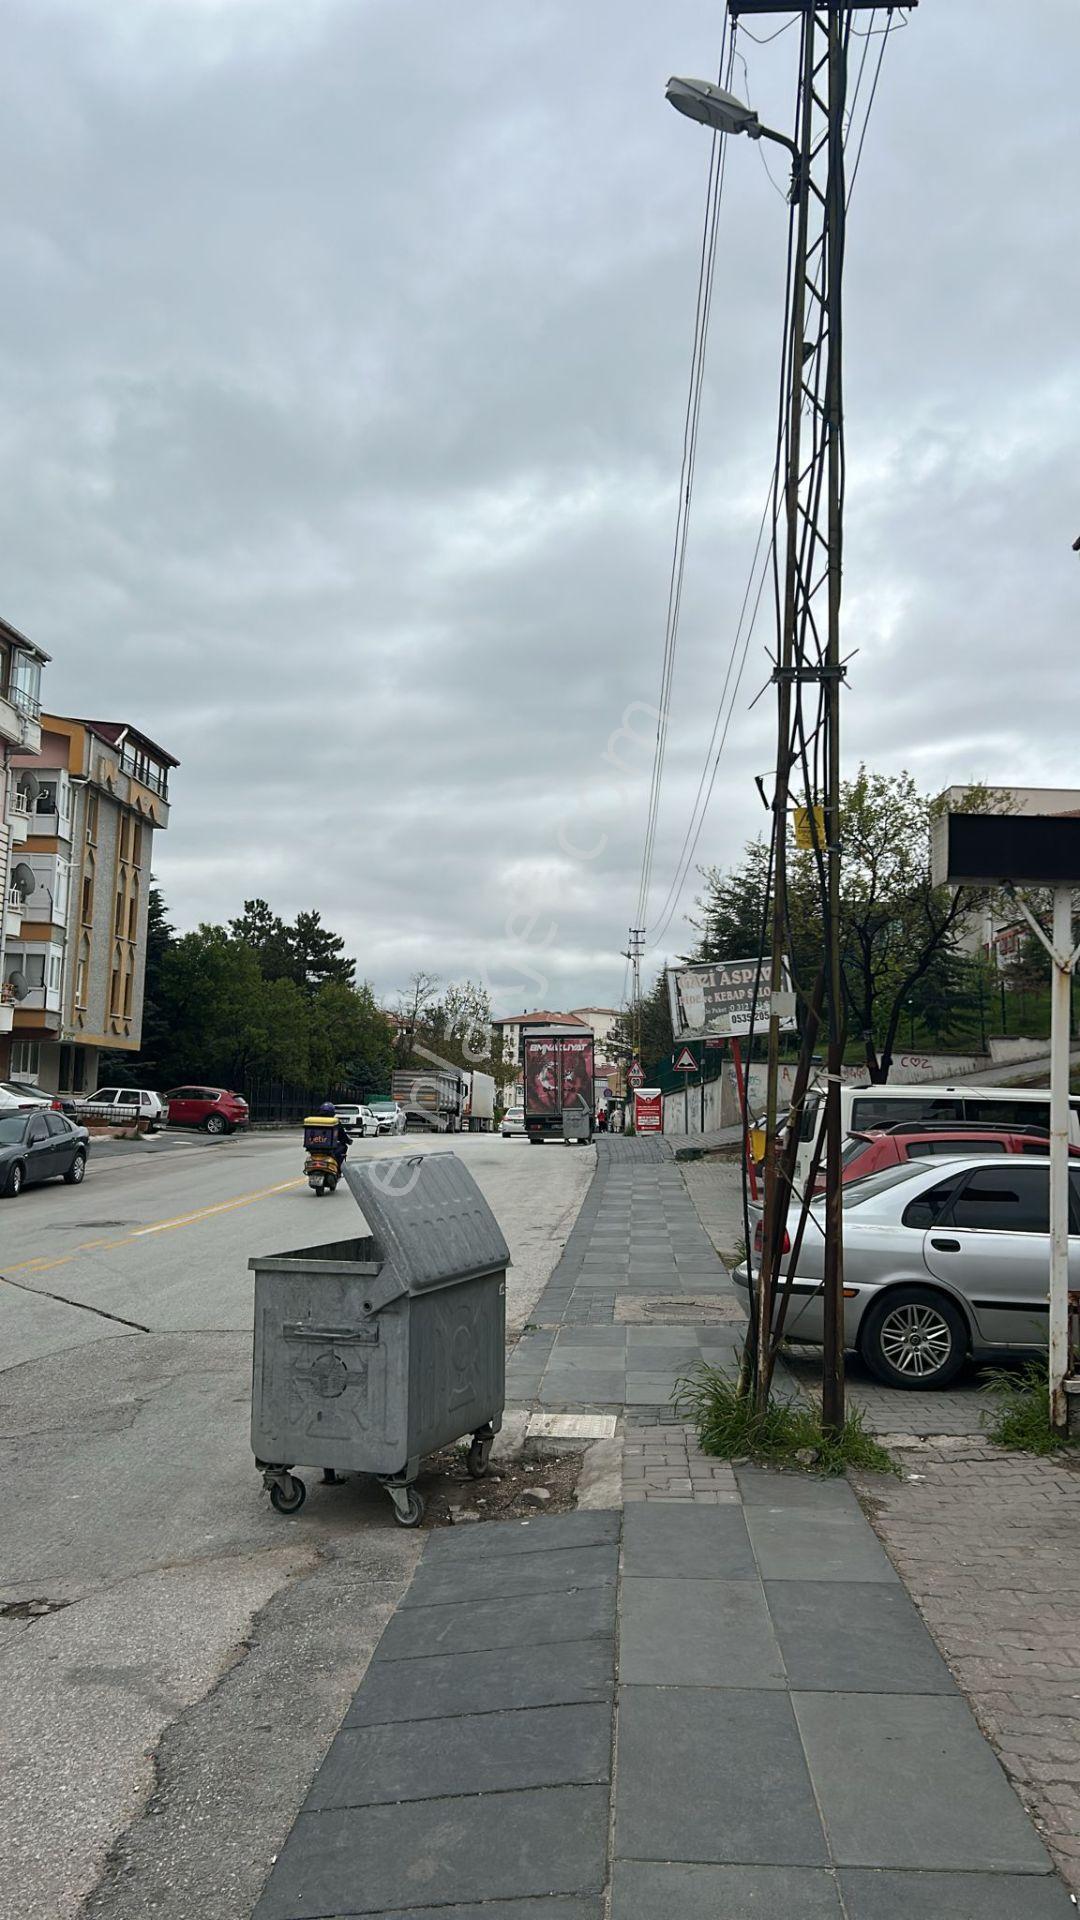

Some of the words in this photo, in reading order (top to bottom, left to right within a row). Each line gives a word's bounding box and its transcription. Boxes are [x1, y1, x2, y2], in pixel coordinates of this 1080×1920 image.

[720, 966, 773, 986] ASPAV
[714, 989, 746, 1003] KEBAP
[731, 1013, 752, 1024] 0535
